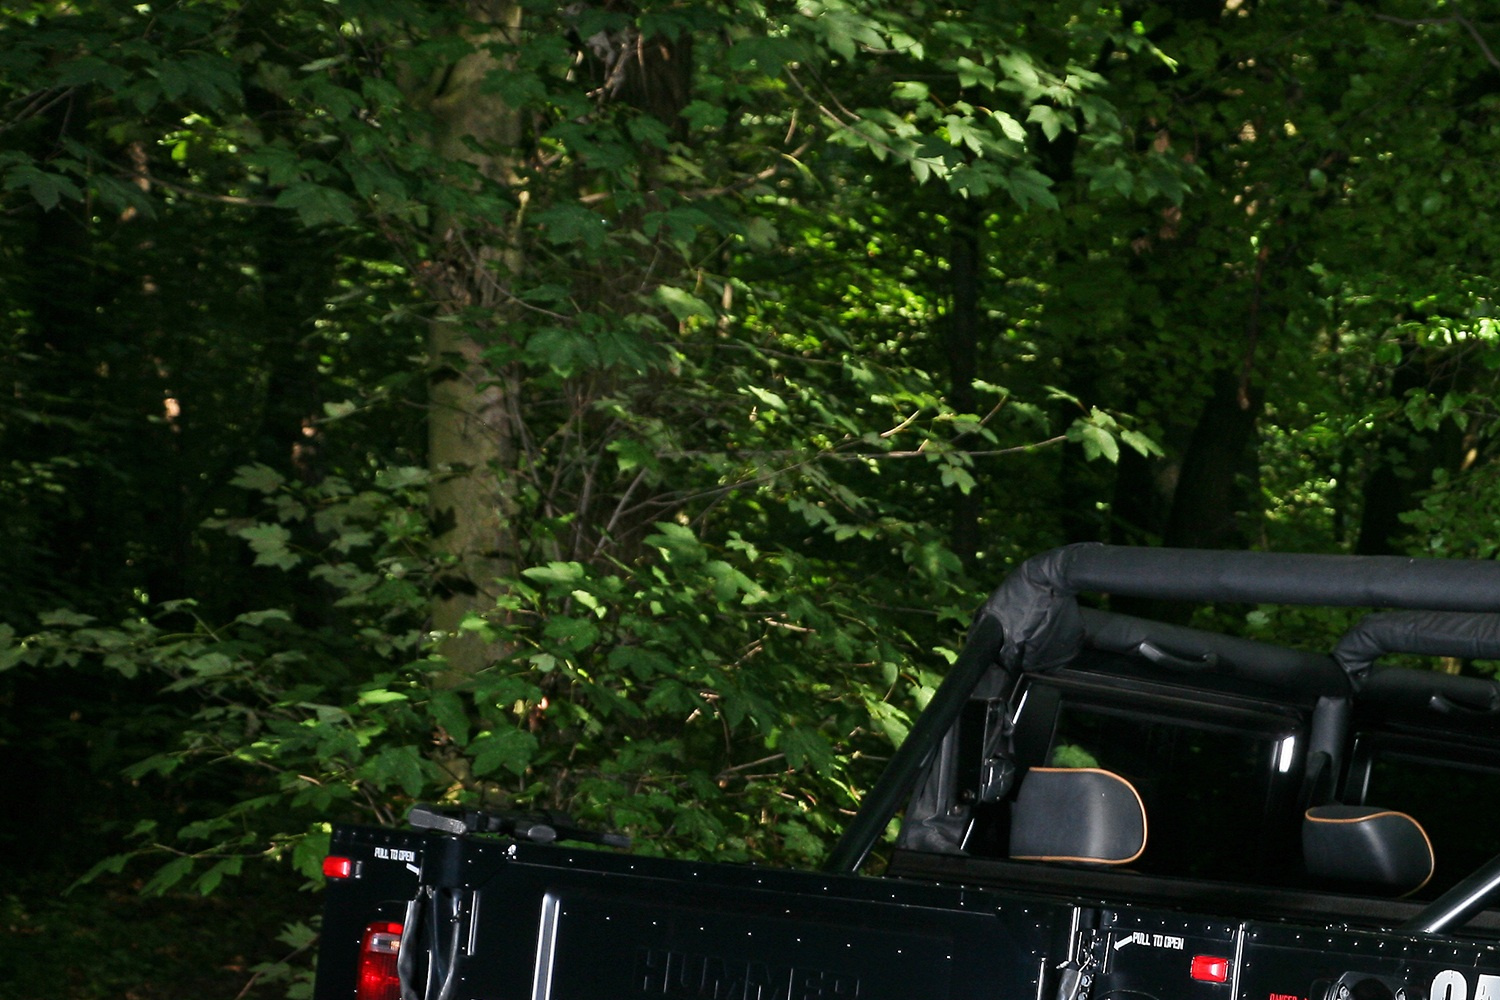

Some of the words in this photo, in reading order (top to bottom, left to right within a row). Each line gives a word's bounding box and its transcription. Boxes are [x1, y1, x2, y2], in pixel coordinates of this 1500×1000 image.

[374, 847, 390, 860] PULL
[390, 848, 399, 860] TO
[398, 850, 415, 862] OPEN
[1132, 931, 1151, 946] PULL
[1153, 934, 1163, 948] TO
[1163, 935, 1184, 950] OPEN
